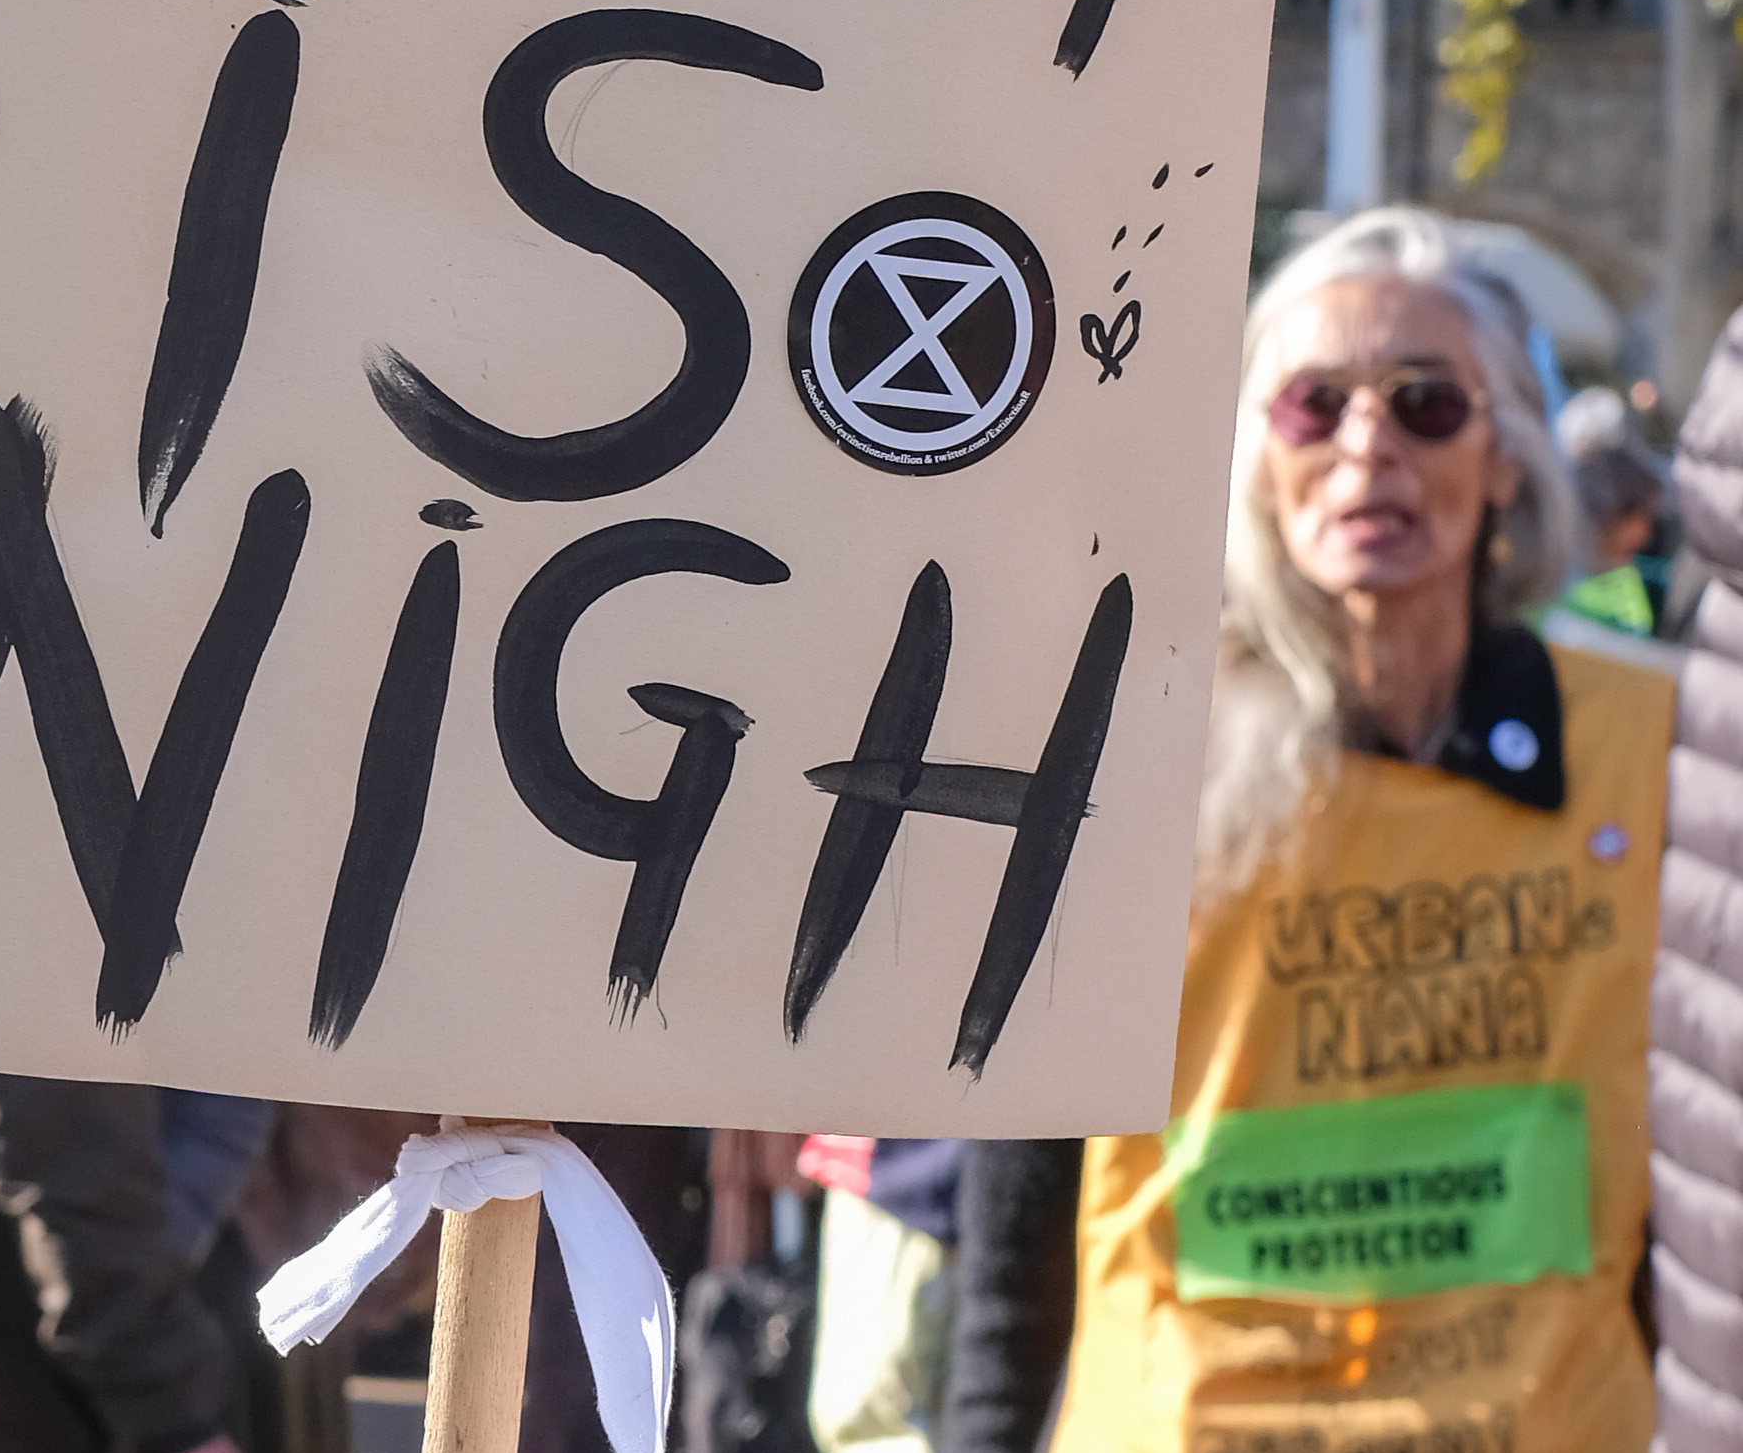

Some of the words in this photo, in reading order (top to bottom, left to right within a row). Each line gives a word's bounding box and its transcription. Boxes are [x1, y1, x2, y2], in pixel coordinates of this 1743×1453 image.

[801, 368, 923, 465] facebook.com/extinctionrebellion
[924, 454, 933, 464] &
[934, 390, 1032, 464] twitter.com/ExtinctionR
[1205, 1161, 1508, 1224] CONSCIENTIOUS
[1250, 1220, 1474, 1274] PROTECTOR
